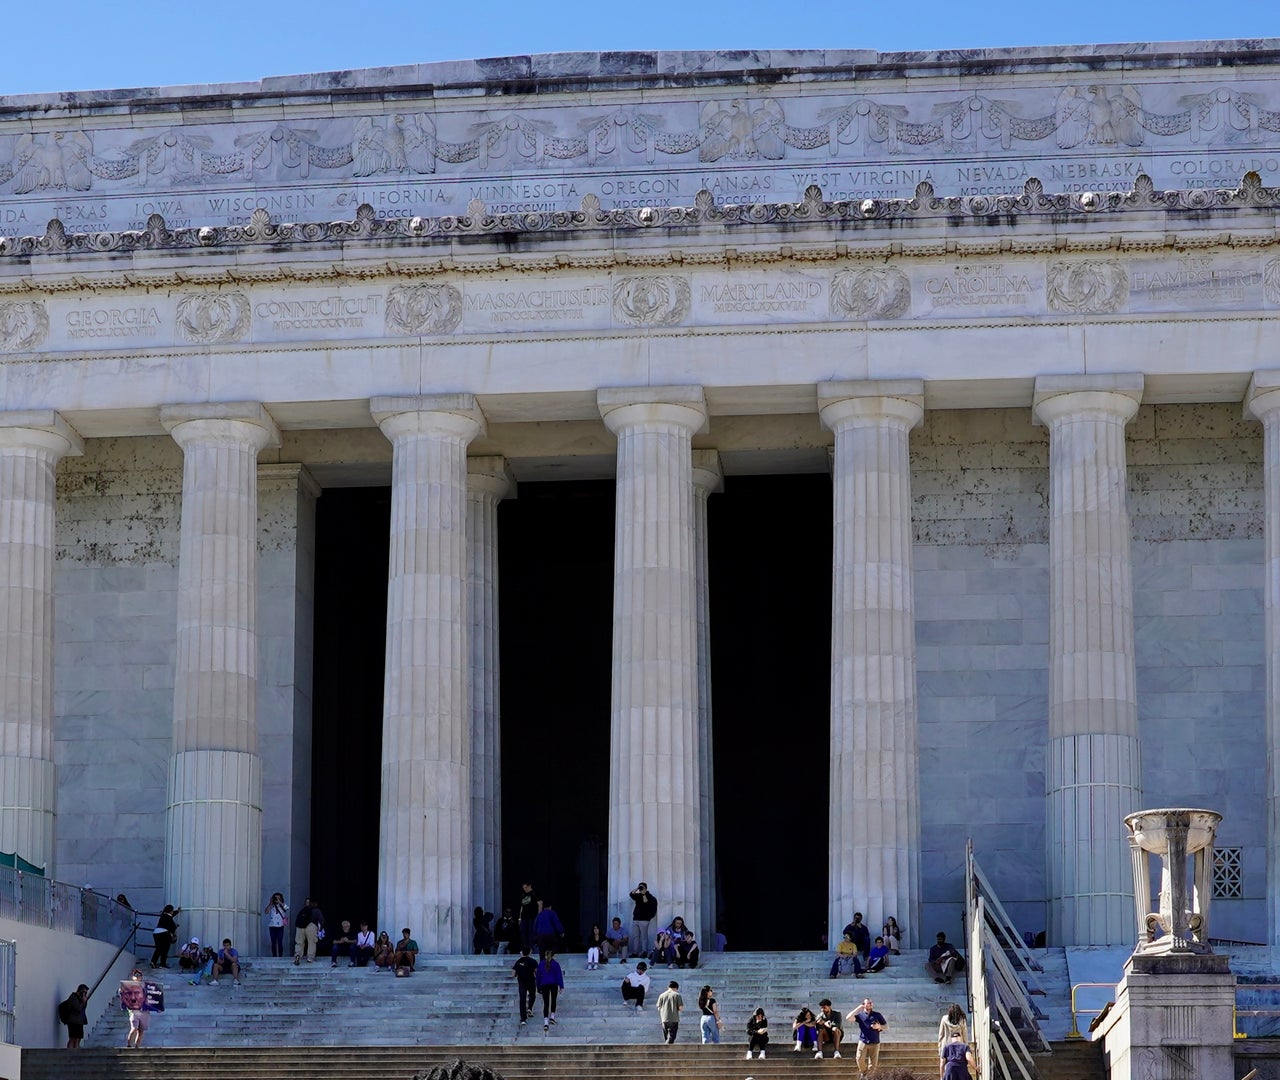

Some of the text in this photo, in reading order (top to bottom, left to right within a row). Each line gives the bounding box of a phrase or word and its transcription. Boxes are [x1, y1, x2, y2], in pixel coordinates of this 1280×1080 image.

[958, 163, 1029, 181] NEVADA
[1051, 161, 1145, 180] NEBRASKA
[1170, 158, 1279, 174] COLORADO
[701, 175, 771, 190] KANSAS
[792, 169, 936, 187] WEST VIRGINIA
[470, 183, 580, 201] MINNESOTA
[601, 179, 680, 195] OREGON
[830, 190, 897, 200] MDCCCLXIII
[209, 195, 315, 211] WISCONSIN
[337, 188, 446, 205] CALIFORNIA
[613, 199, 670, 209] MDCCCLIX
[717, 195, 766, 205] DCCCLXI
[53, 204, 108, 220] TEXAS
[135, 201, 185, 216] IOWA
[379, 209, 415, 218] DCCCL
[491, 203, 556, 213] MDCCCLVIII
[63, 224, 110, 233] DCCCXLV
[954, 264, 1004, 276] SOUTH
[1177, 258, 1214, 270] NEW
[925, 275, 1033, 294] CAROLINA
[1132, 270, 1259, 291] HAMPSHIRE
[464, 286, 610, 310] MASSACHUSETTS
[700, 281, 822, 302] MARYLAND
[255, 295, 382, 318] CONNECTICUT
[65, 307, 162, 326] GEORGIA
